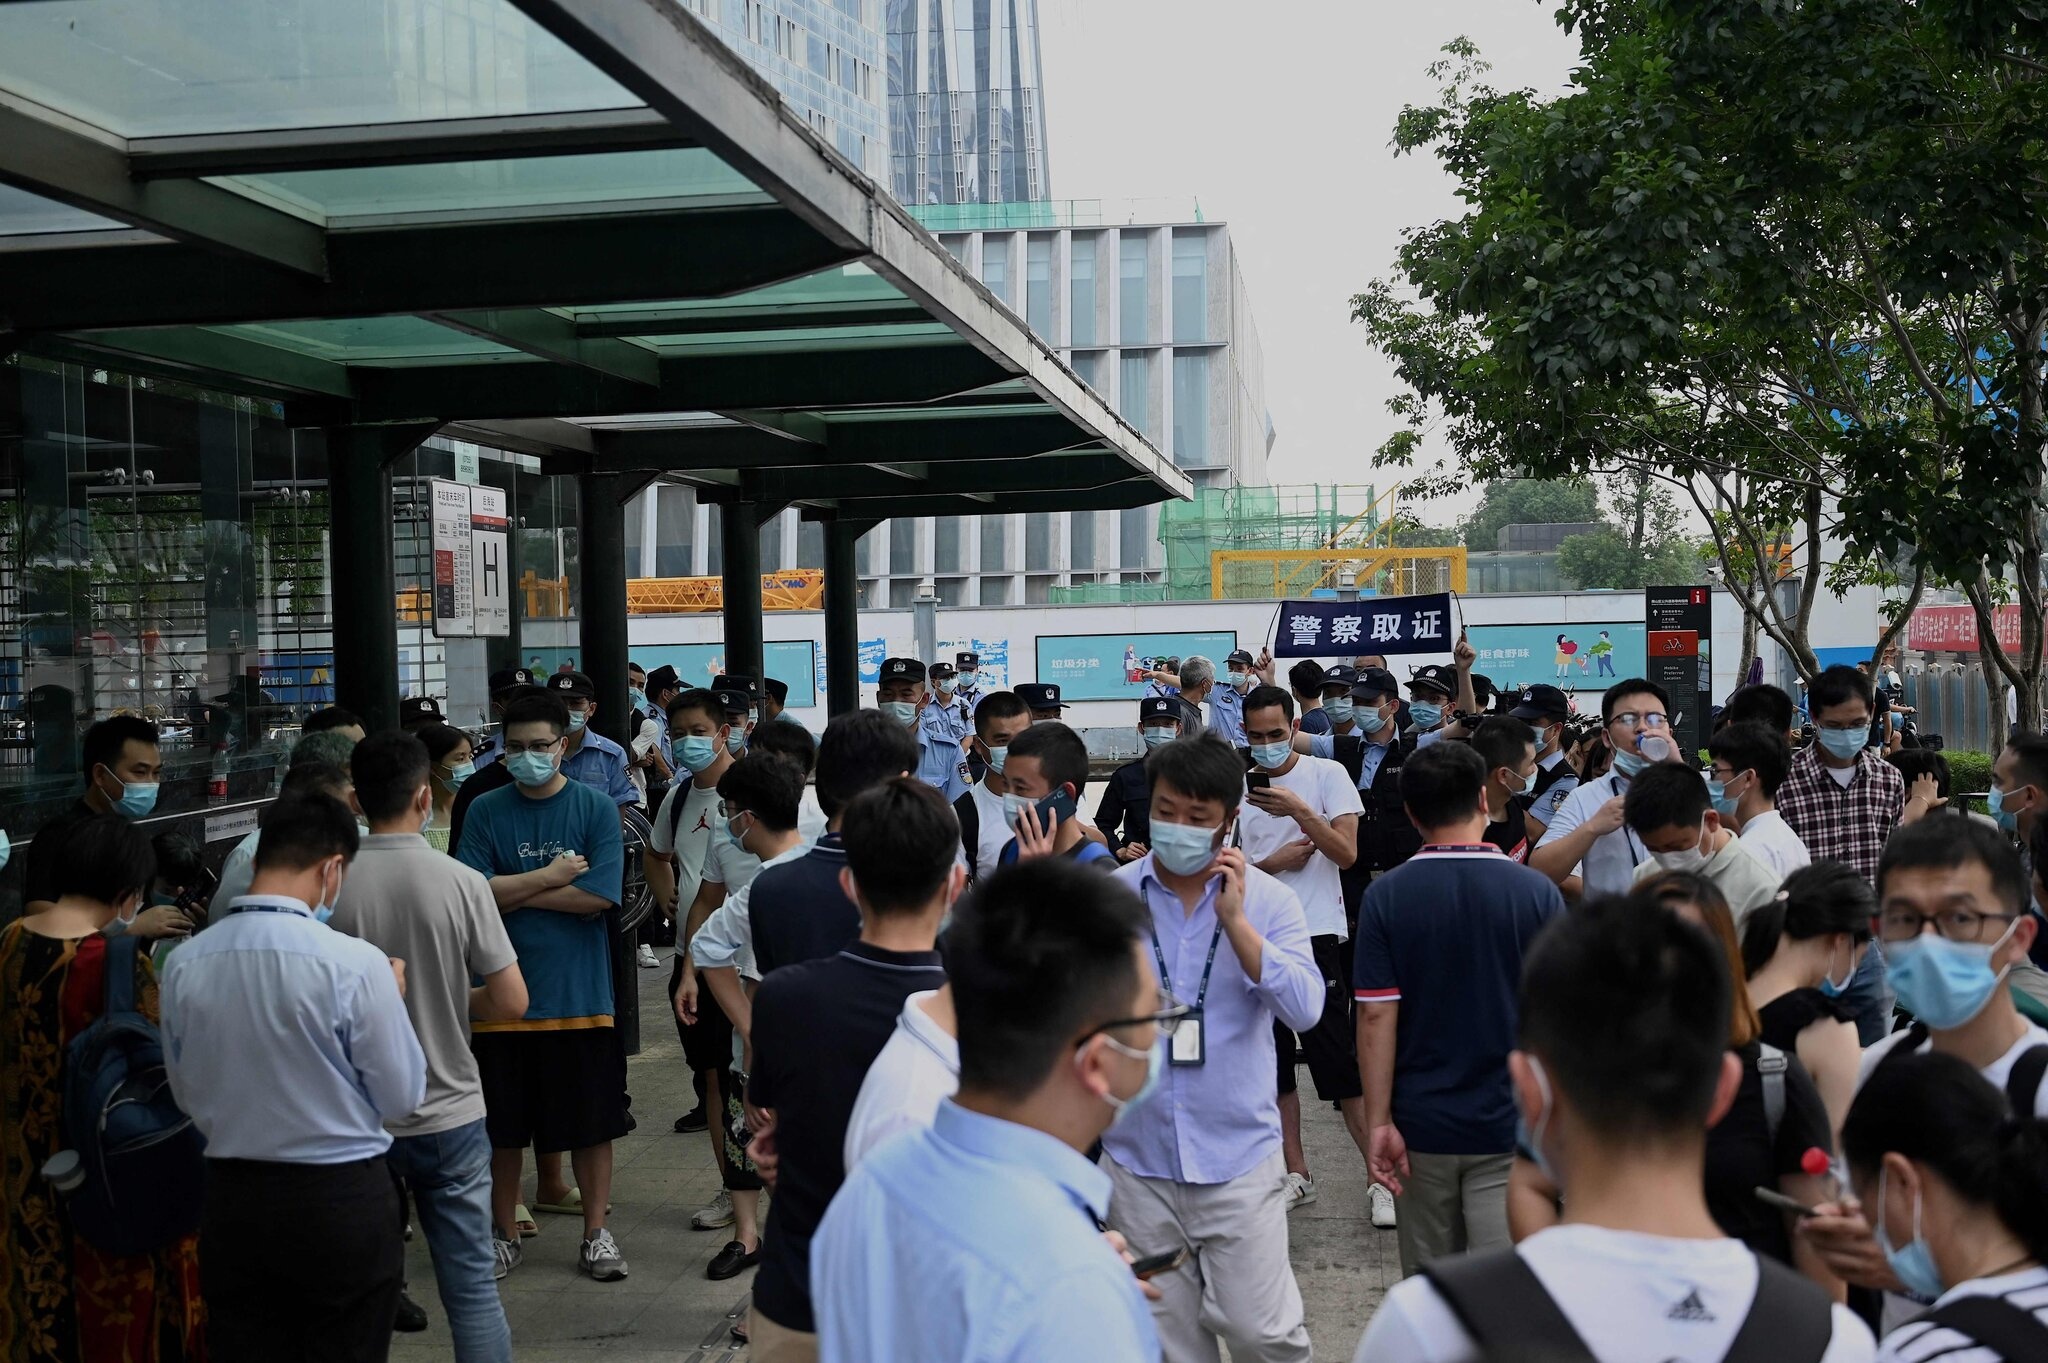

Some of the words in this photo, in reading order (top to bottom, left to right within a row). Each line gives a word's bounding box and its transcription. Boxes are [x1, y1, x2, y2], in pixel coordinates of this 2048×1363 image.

[483, 541, 499, 597] H
[1289, 610, 1443, 646] 警察取证
[1051, 657, 1100, 670] 垃圾分类
[1479, 648, 1531, 660] 拒食野味
